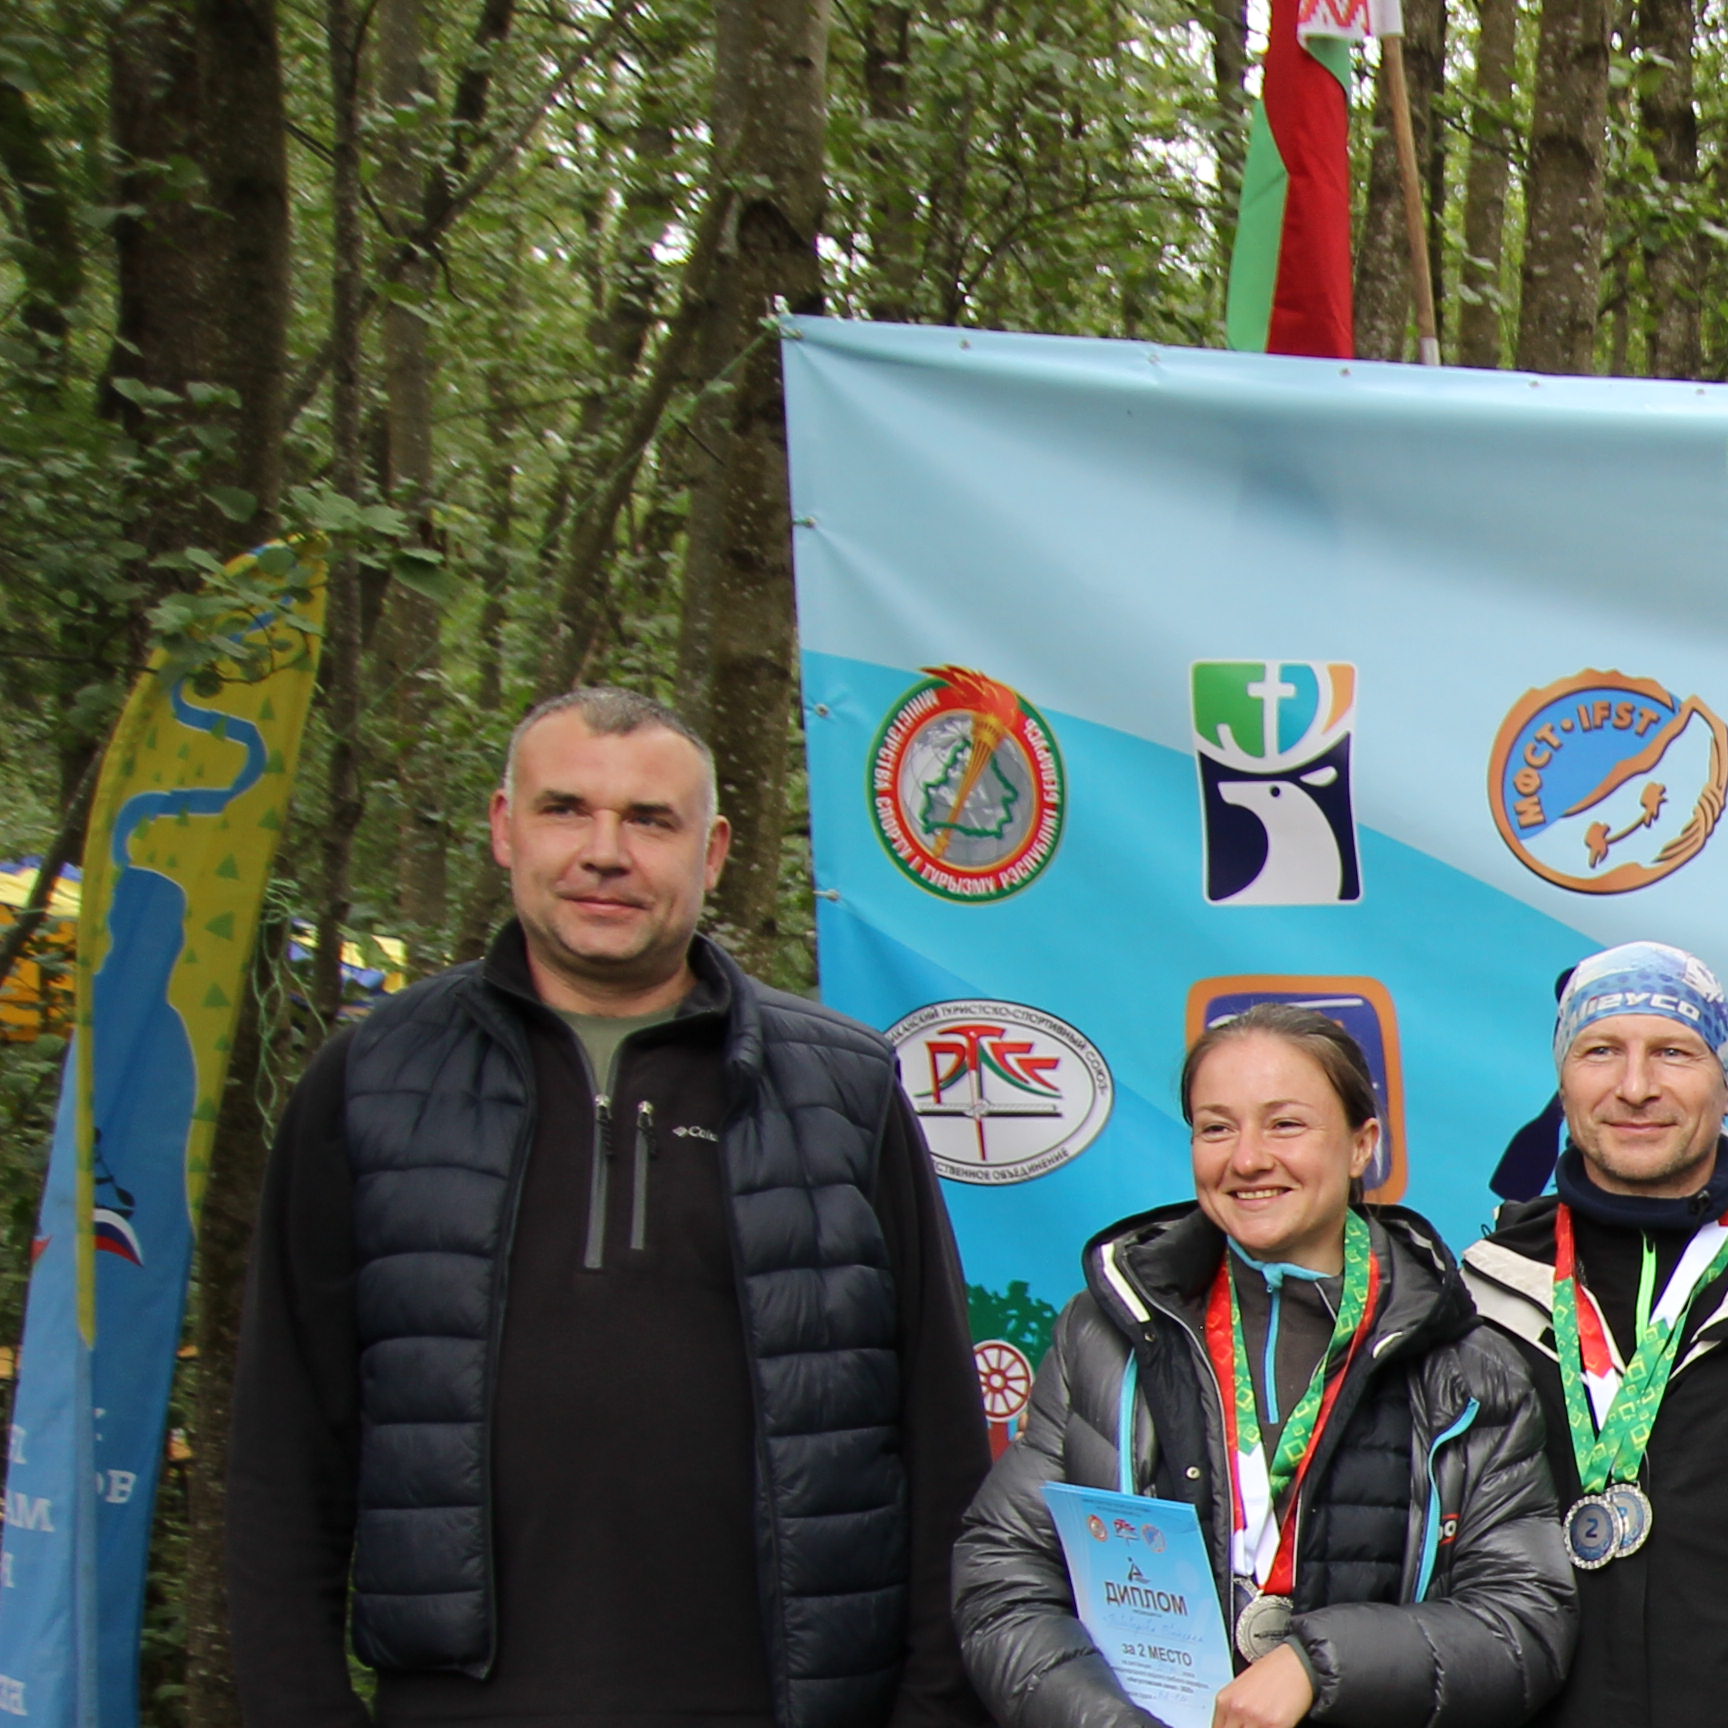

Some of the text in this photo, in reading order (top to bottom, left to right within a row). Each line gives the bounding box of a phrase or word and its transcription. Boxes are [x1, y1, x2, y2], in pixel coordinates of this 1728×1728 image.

[874, 687, 941, 791] МІНІСТЭРСТВА
[1576, 700, 1661, 738] IFST
[1024, 717, 1061, 804] БЕЛАРУСЬ
[1513, 723, 1564, 830] МФСТ
[875, 796, 912, 860] СПОРТУ
[998, 808, 1060, 891] РЭСПУБЛІКІ
[920, 864, 997, 896] ТУРЫЗМУ
[941, 1003, 1086, 1052] ТУРИСТСКО-СПОРТИВНЫЙ
[935, 1147, 1070, 1181] СТВЕННОЕ ОБЪЕДИНЕНИЕ
[1585, 1518, 1599, 1538] 2
[1105, 1581, 1189, 1617] ДИПЛОМ
[1121, 1643, 1193, 1667] за 2 МЕСТО
